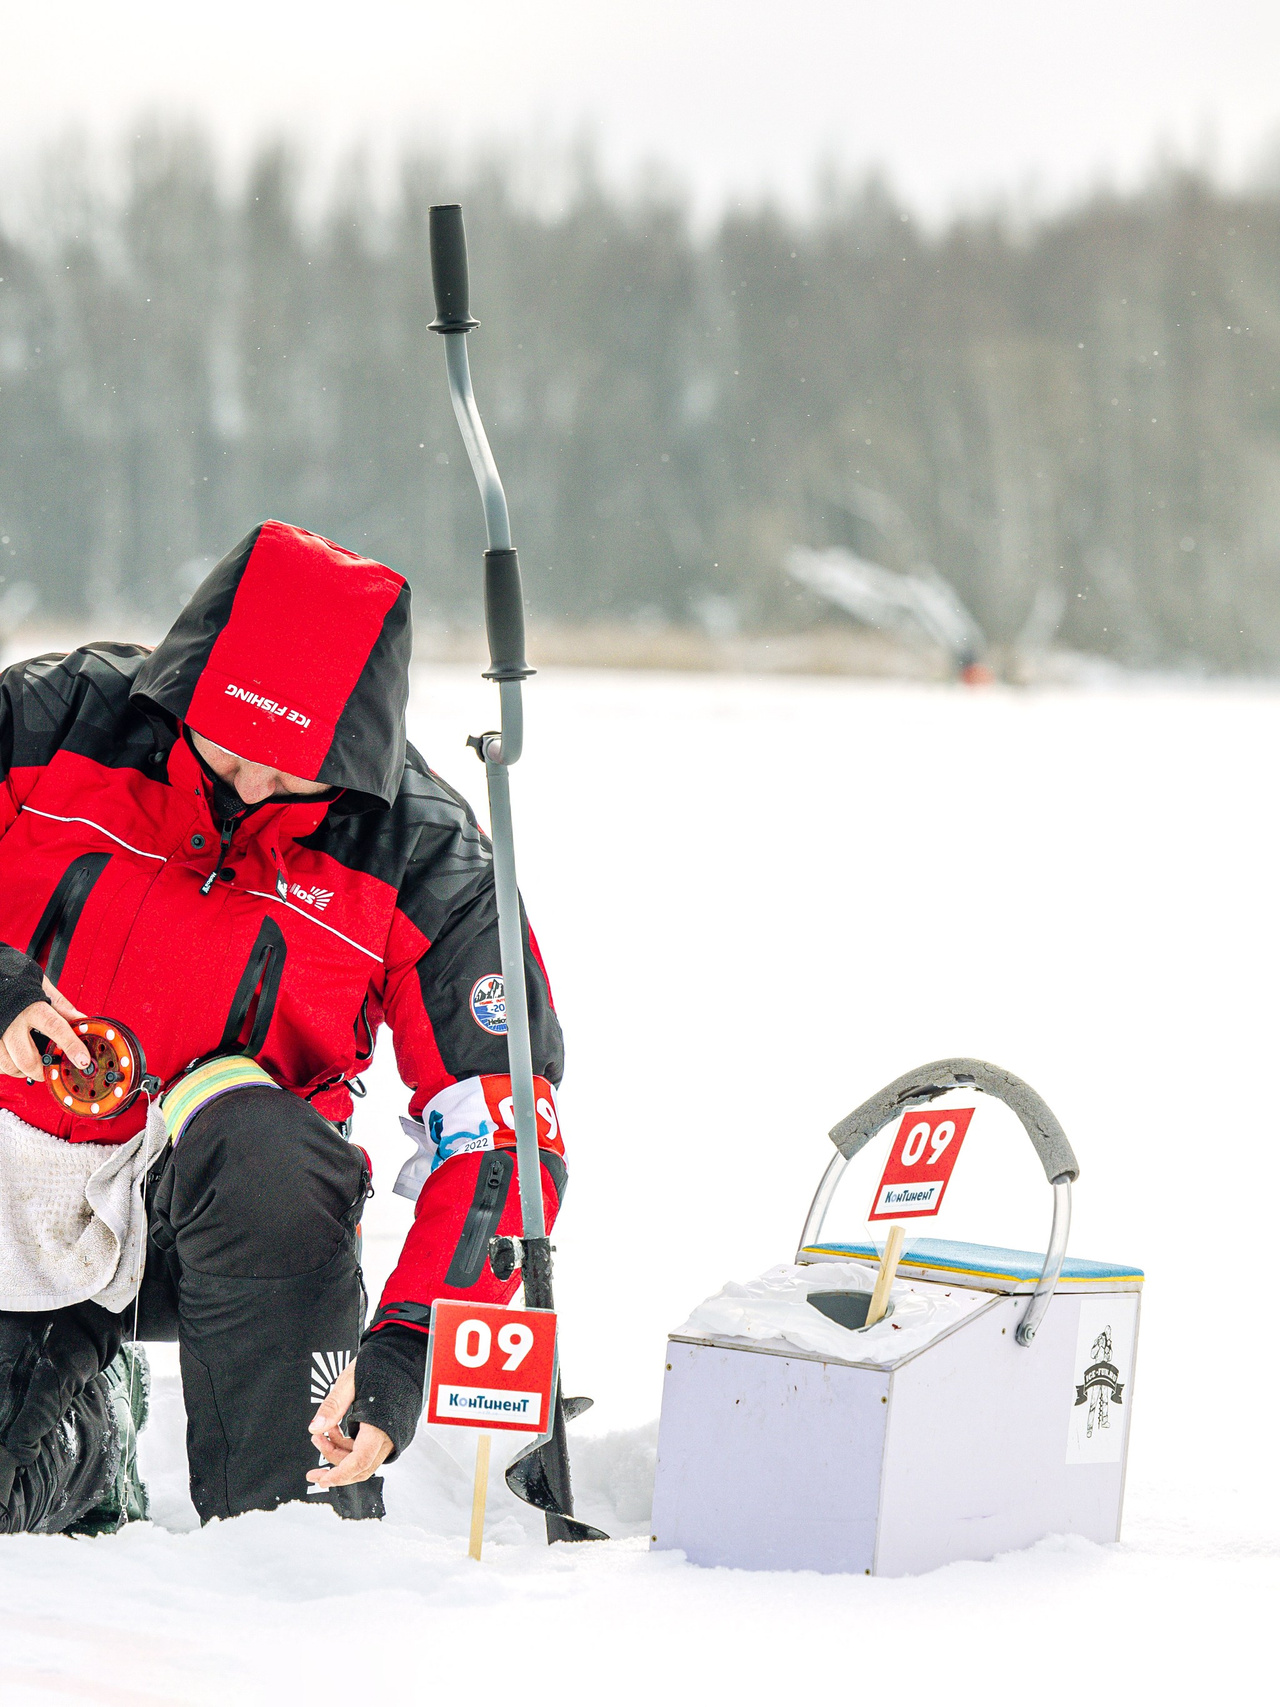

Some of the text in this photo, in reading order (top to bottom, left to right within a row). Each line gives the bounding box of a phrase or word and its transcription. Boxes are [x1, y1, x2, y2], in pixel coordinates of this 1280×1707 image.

[224, 684, 311, 729] ICE FISHING
[464, 1137, 489, 1152] 2022
[901, 1120, 956, 1167] 09
[454, 1318, 534, 1372] 09
